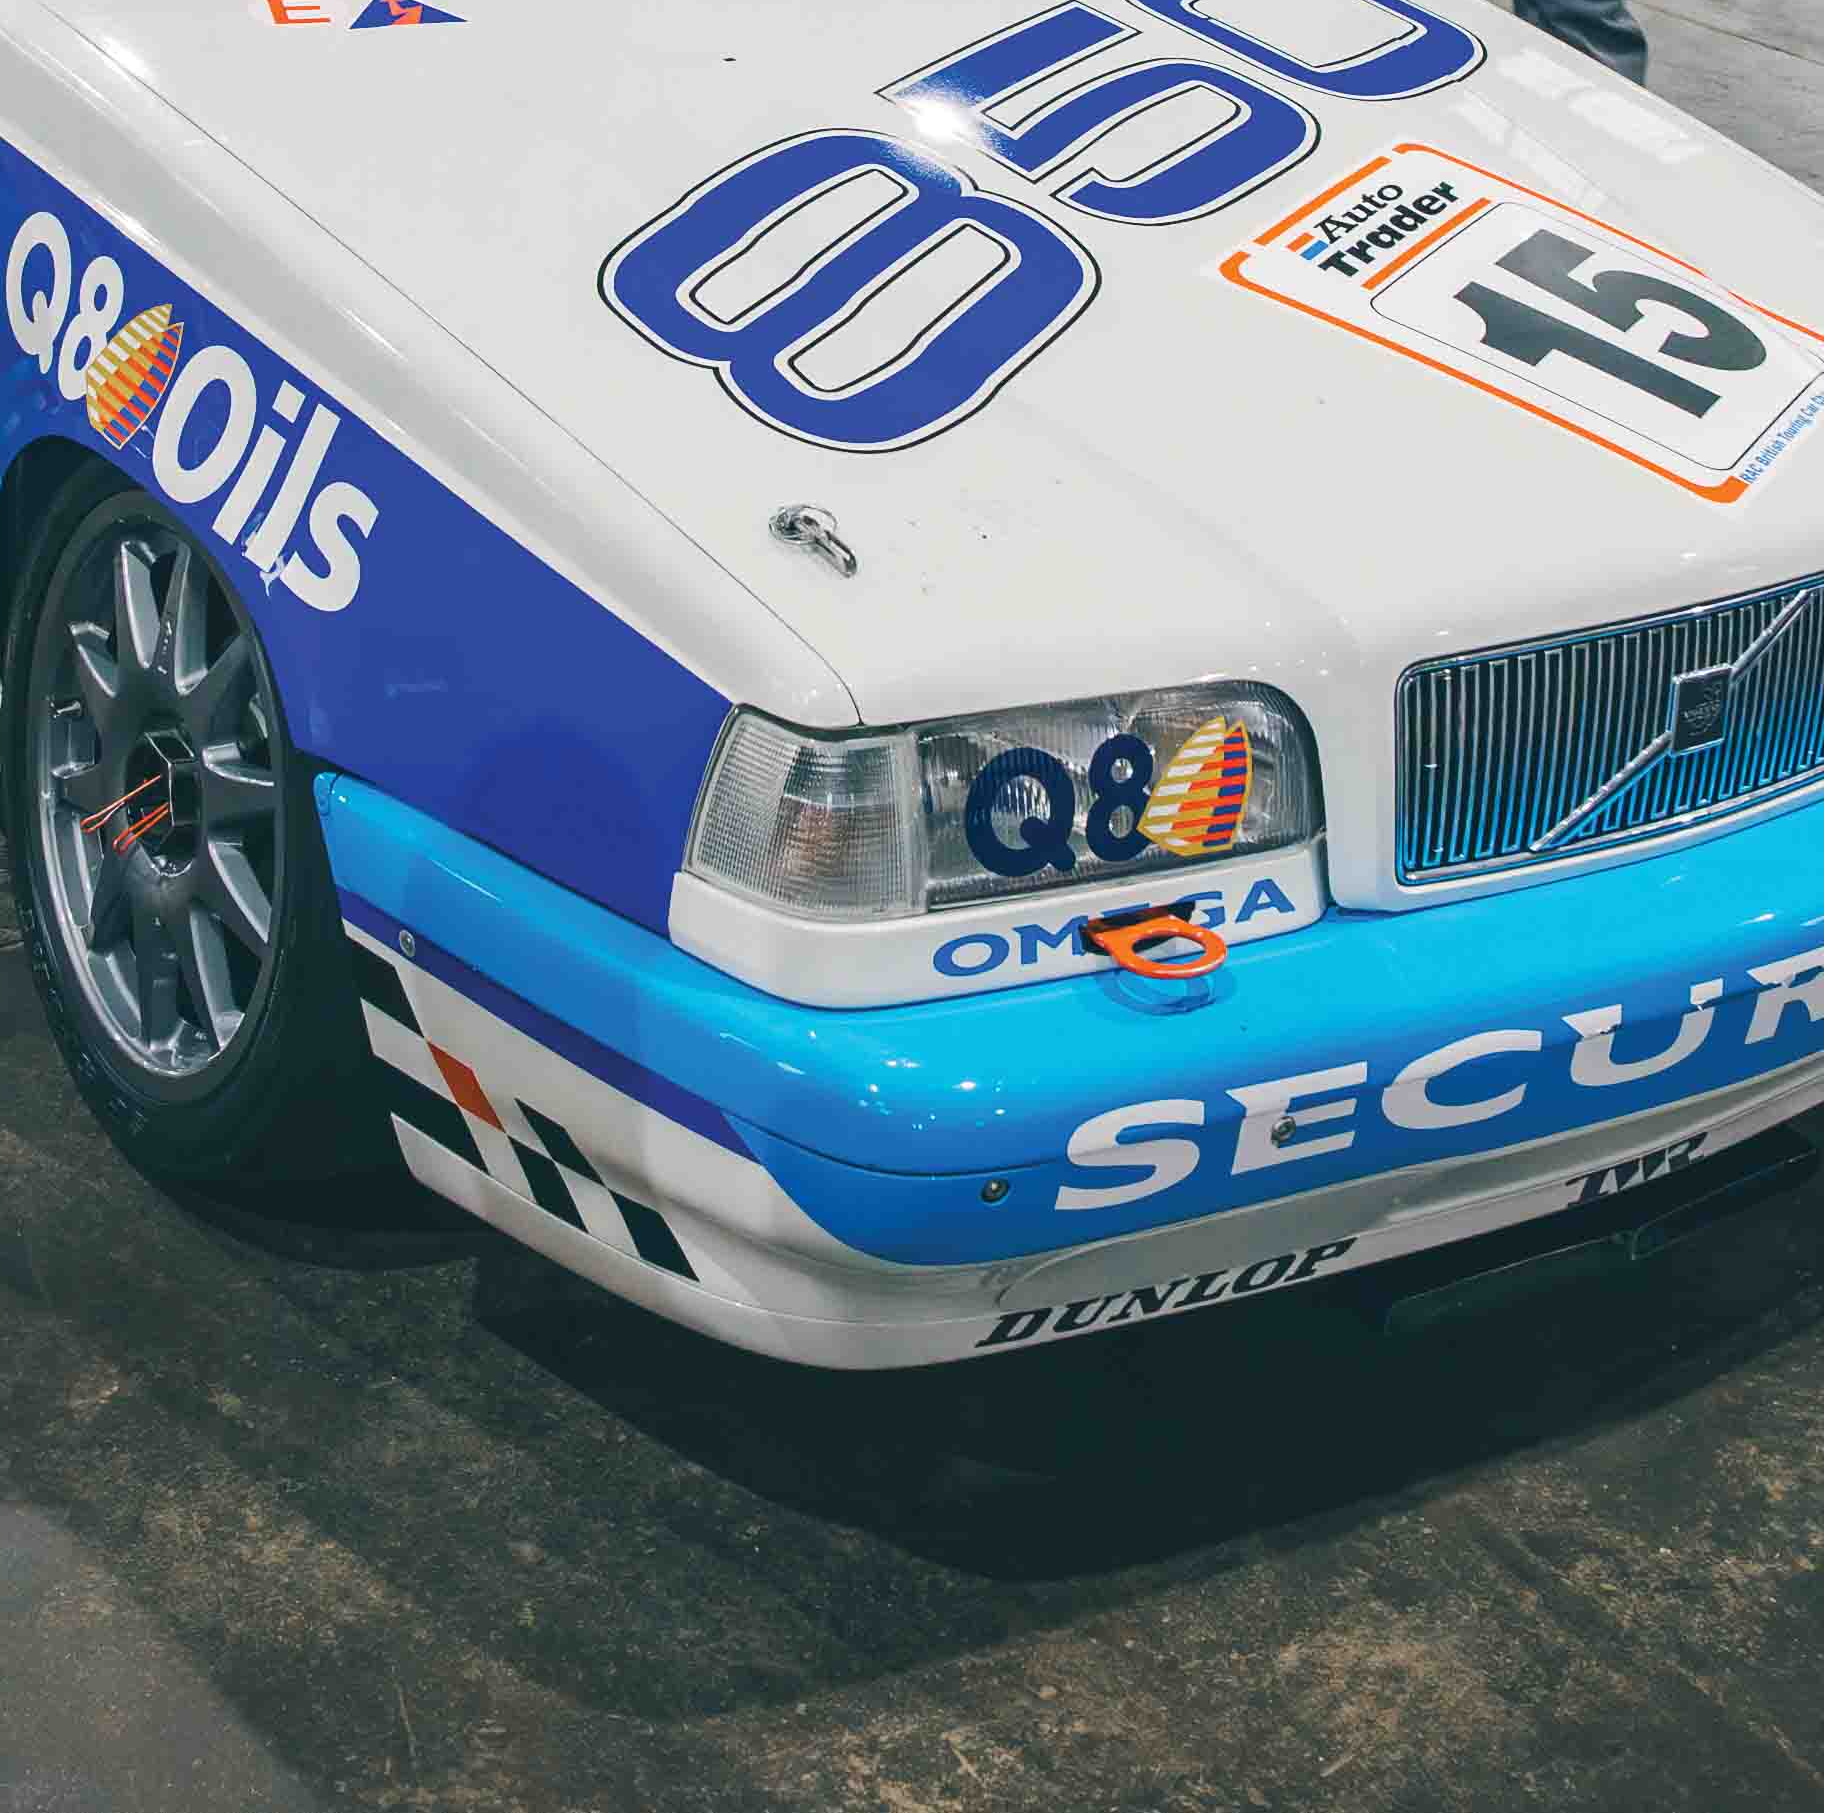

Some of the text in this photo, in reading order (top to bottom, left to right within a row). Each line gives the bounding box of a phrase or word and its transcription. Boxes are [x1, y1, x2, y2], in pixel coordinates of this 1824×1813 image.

[1313, 183, 1405, 244] Auto
[1316, 181, 1460, 279] Trader
[1452, 228, 1767, 420] 15
[5, 210, 380, 613] Q8 Oils
[964, 732, 1156, 879] Q8
[933, 878, 1296, 977] OMGA
[975, 1236, 1359, 1349] DUNLOP
